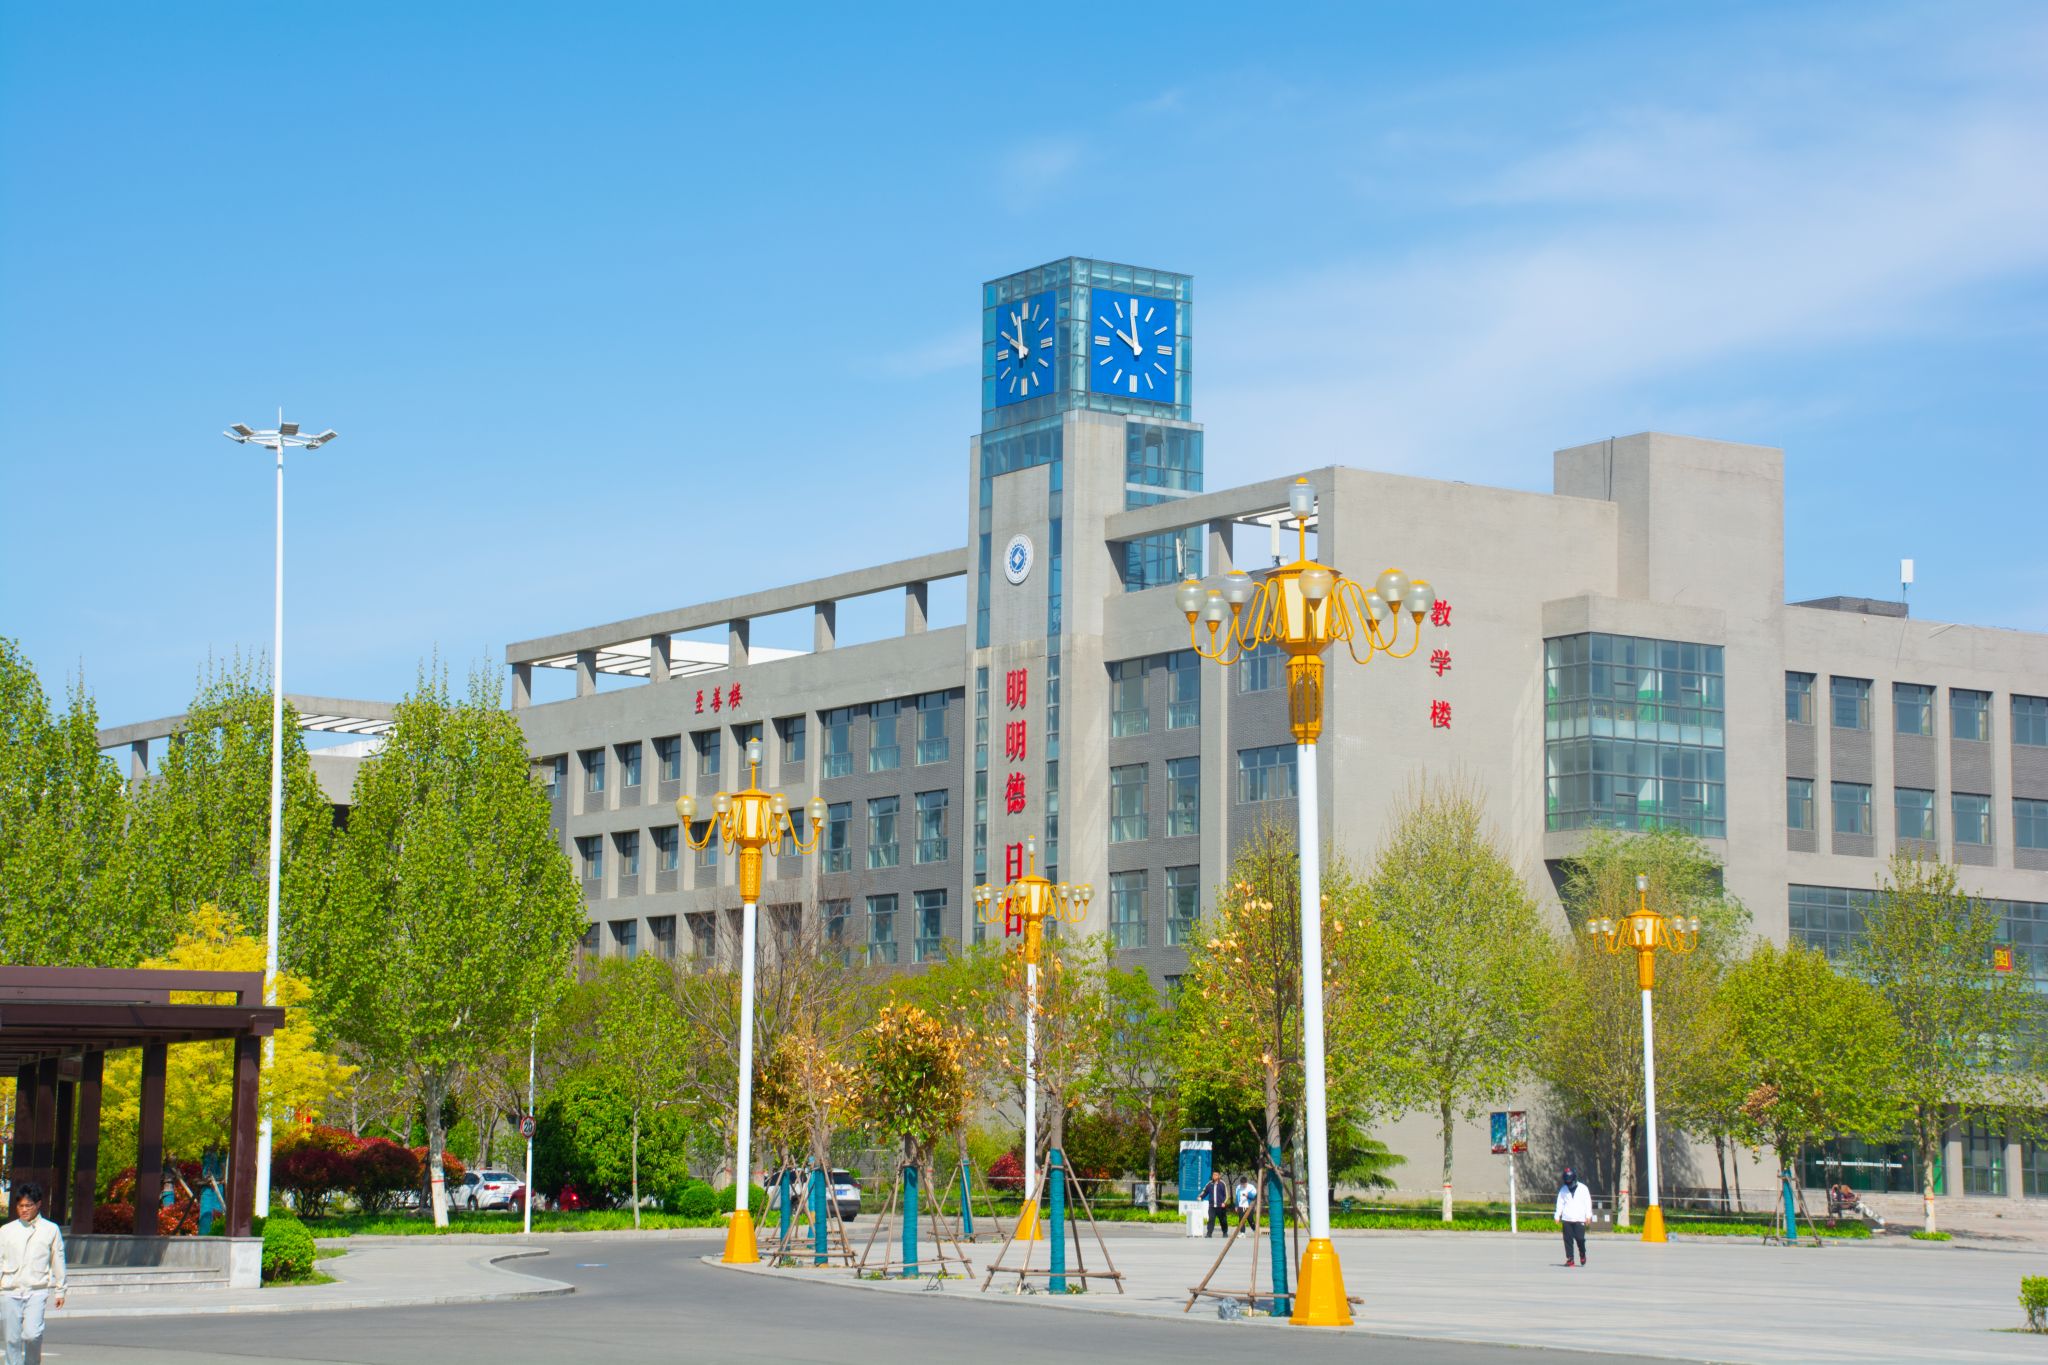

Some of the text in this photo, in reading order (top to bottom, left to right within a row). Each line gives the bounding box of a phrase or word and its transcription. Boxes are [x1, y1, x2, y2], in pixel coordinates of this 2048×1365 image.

[1430, 599, 1453, 730] 教学楼
[523, 1121, 533, 1133] 20
